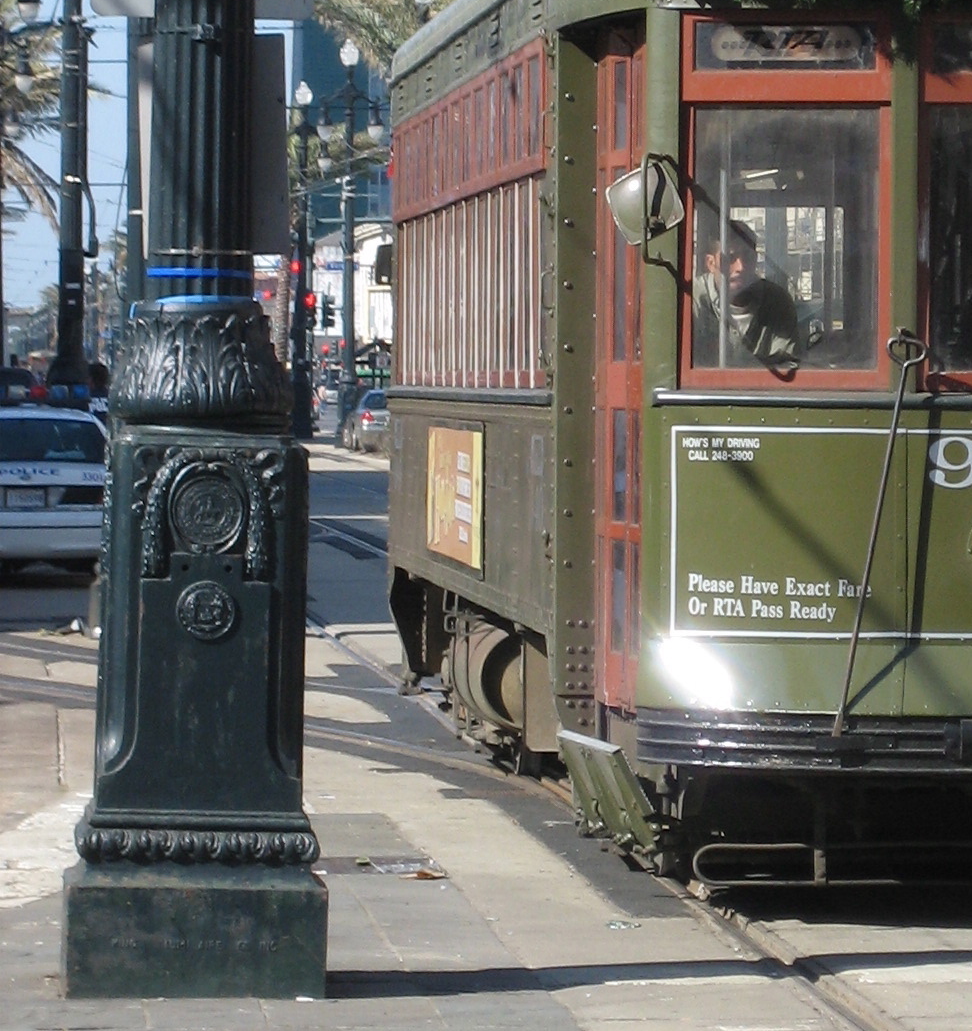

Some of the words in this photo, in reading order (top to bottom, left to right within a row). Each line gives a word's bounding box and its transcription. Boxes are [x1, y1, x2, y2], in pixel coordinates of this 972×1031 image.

[682, 437, 709, 448] HOW'S
[711, 438, 725, 448] MY
[727, 438, 760, 448] DRIVING
[688, 450, 709, 461] CALL
[711, 450, 754, 461] 248-3900
[688, 573, 734, 593] Please
[741, 576, 778, 595] Have
[785, 577, 831, 597] Exact
[838, 579, 872, 598] Fare
[688, 596, 708, 615] Or
[713, 598, 745, 617] RTA
[751, 599, 784, 618] Pass
[789, 600, 836, 622] Ready
